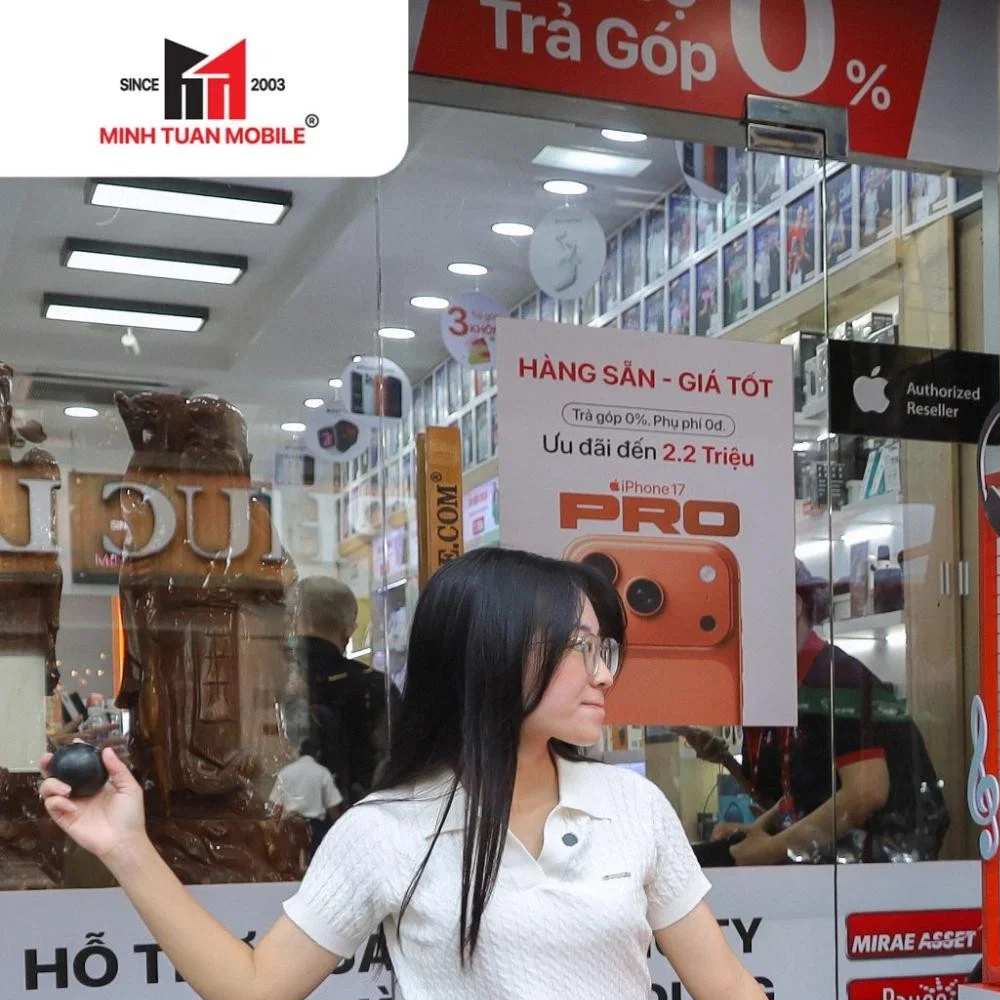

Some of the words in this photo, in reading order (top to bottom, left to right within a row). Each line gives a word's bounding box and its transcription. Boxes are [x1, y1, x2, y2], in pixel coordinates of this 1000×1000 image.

[480, 1, 581, 62] Trả
[596, 18, 717, 91] Góp
[518, 354, 597, 384] HÀNG
[602, 360, 656, 389] SẴN
[678, 369, 721, 394] GIÁ
[726, 370, 774, 398] TỐT
[906, 381, 981, 401] Authorized
[572, 408, 594, 422] Trả
[596, 410, 622, 426] góp
[653, 415, 679, 429] Phụ
[682, 417, 702, 432] phí
[906, 401, 960, 419] Reseller
[542, 431, 573, 455] Ưu
[578, 437, 611, 458] đãi
[616, 437, 657, 460] đến
[662, 443, 697, 463] 2.2
[701, 445, 755, 471] Triệu
[621, 480, 670, 496] iPhone
[672, 483, 686, 496] 17
[559, 491, 741, 538] PRO
[852, 933, 916, 954] MIRAE
[917, 930, 977, 950] ASSET
[24, 931, 119, 991] HỖ
